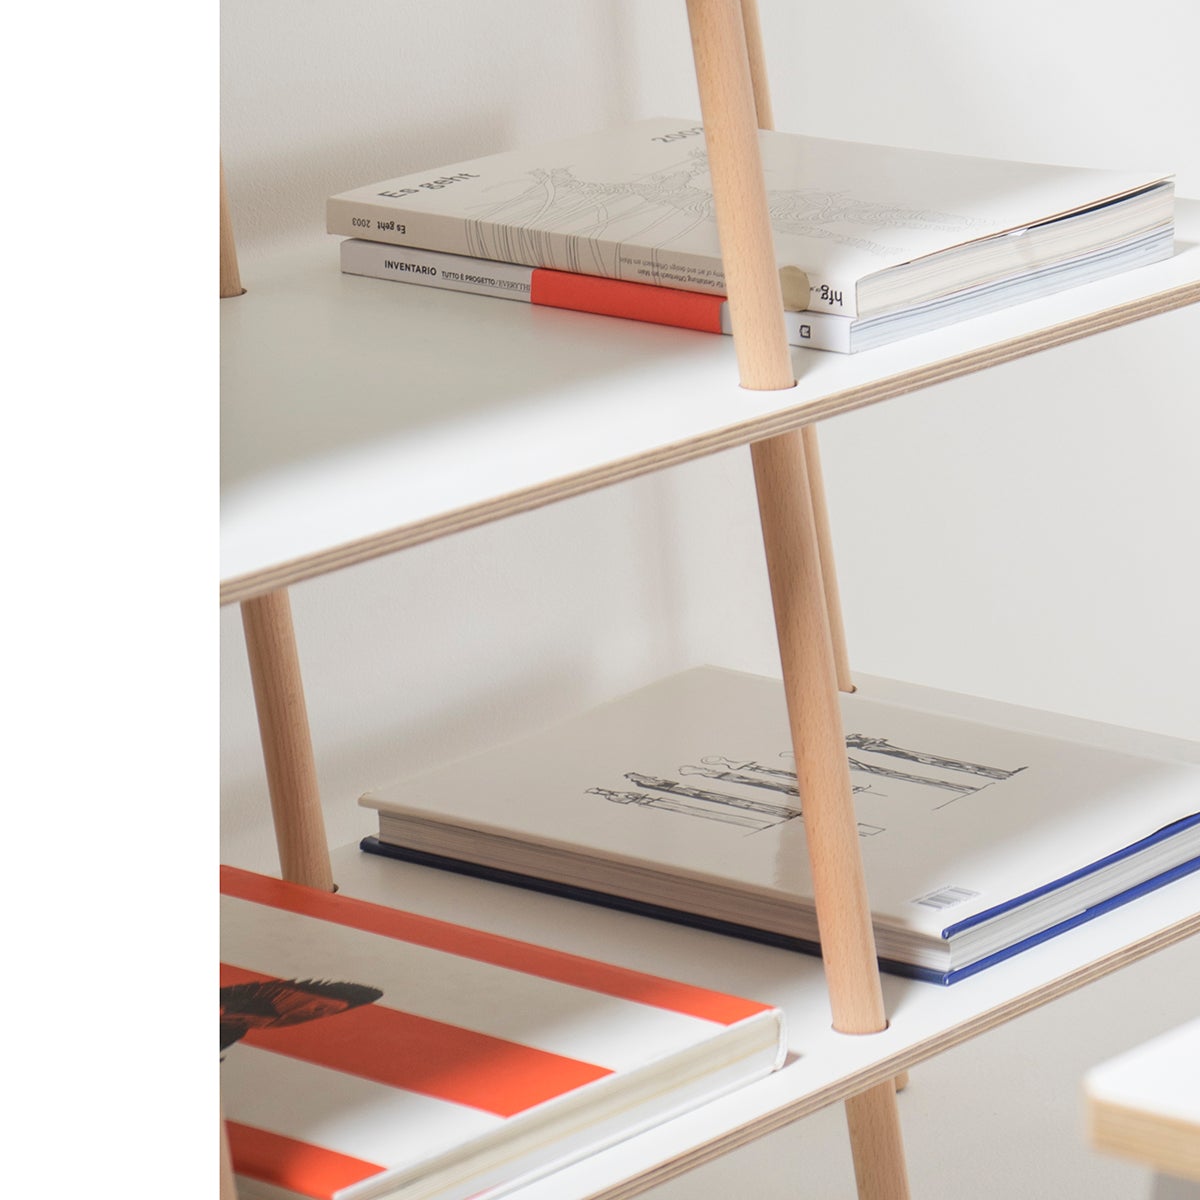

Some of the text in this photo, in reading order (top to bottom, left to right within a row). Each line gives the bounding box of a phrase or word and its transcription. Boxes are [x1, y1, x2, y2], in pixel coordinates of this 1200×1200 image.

[377, 173, 480, 198] Es geht
[352, 217, 406, 234] Es geht 2003
[384, 260, 437, 276] INVENTARIO
[441, 270, 460, 280] TUTTO
[465, 274, 496, 286] PROGETTO
[820, 284, 843, 306] hfg
